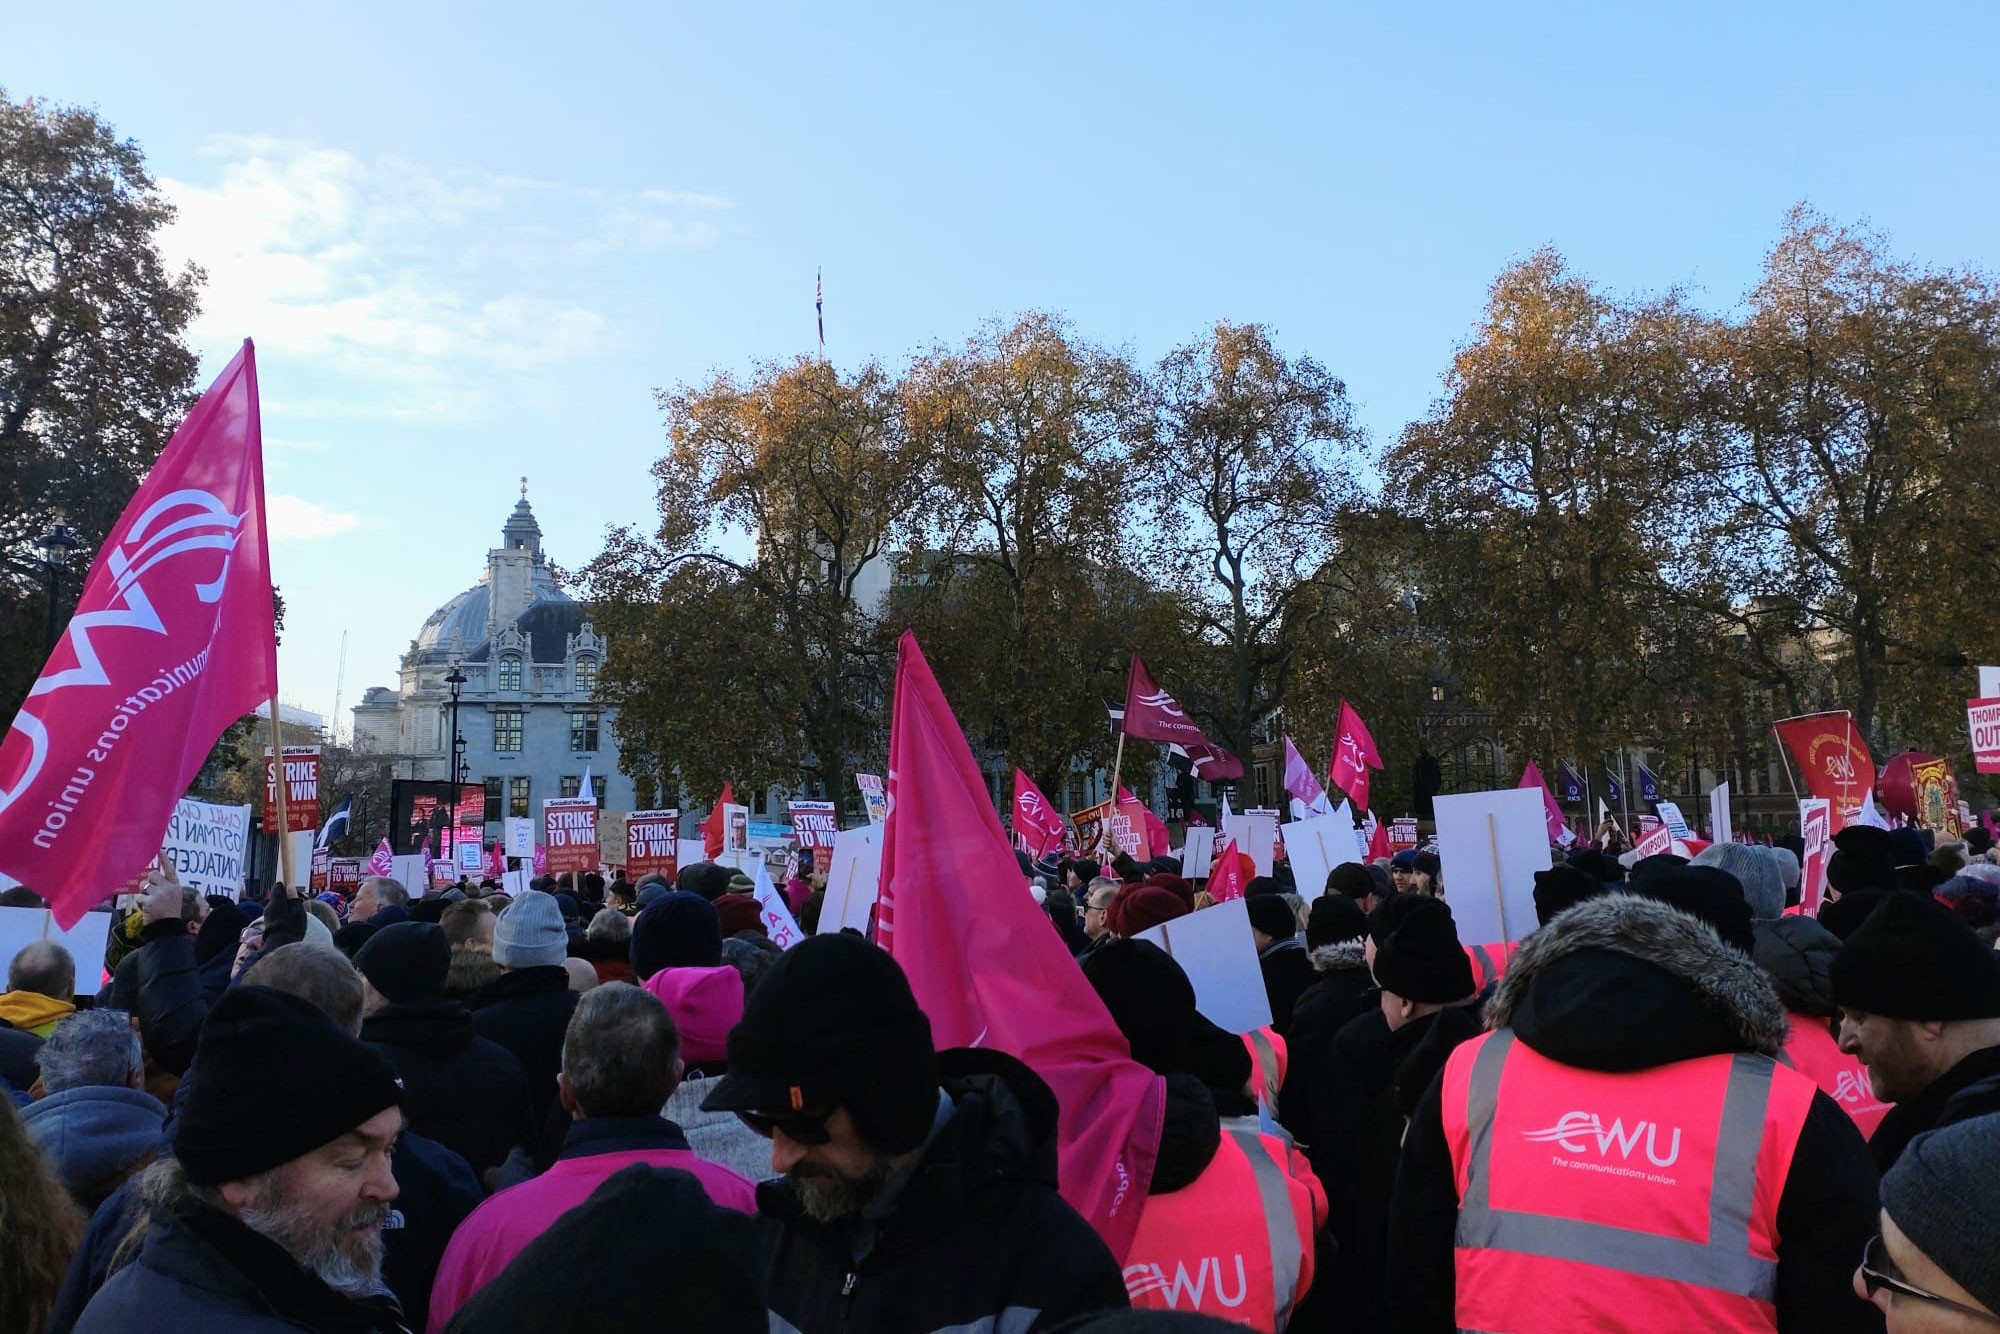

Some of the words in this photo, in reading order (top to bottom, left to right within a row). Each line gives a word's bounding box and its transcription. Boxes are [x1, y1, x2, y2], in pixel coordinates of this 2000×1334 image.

[1159, 720, 1172, 729] The
[267, 761, 317, 783] SRIKE
[290, 781, 317, 802] WIN
[547, 810, 595, 830] STRIKE
[794, 814, 836, 831] STRIKE
[1113, 816, 1130, 826] AVE
[1395, 824, 1417, 834] STRIKE
[547, 829, 566, 847] TO
[568, 828, 596, 846] WIN
[629, 823, 675, 842] STRIKE
[796, 831, 814, 847] TO
[815, 831, 837, 847] WIN
[1118, 834, 1140, 845] OYAL
[1395, 833, 1403, 842] TO
[1404, 833, 1417, 842] WIN
[629, 840, 646, 858] TO
[649, 839, 675, 857] WIN
[1638, 831, 1667, 861] THOMPSON
[332, 865, 358, 874] STRIKE
[332, 874, 342, 882] TO
[343, 873, 358, 882] WIN
[1521, 1111, 1681, 1167] CWU
[1552, 1156, 1569, 1168] The
[1569, 1161, 1646, 1180] communications
[1647, 1173, 1677, 1186] union
